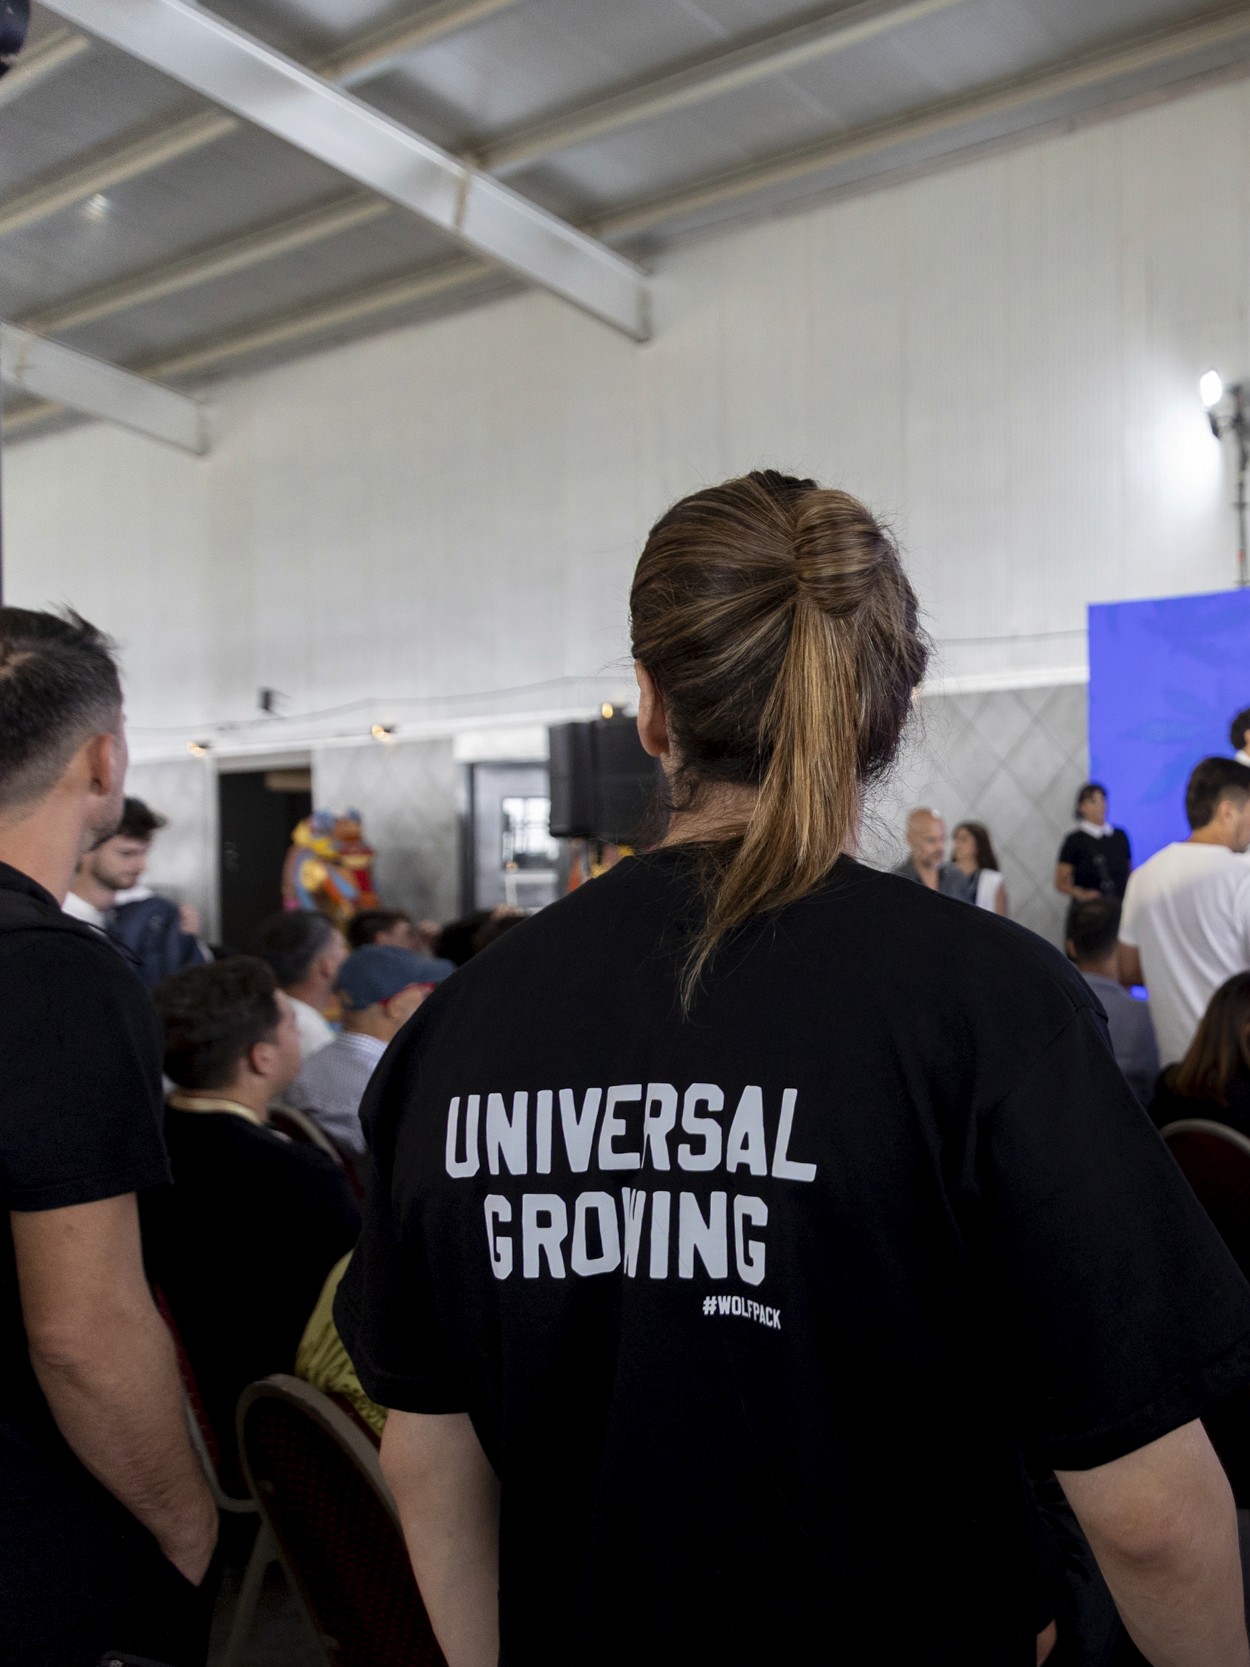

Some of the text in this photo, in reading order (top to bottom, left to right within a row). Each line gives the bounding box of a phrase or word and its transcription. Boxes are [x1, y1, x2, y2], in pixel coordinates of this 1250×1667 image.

[445, 1082, 818, 1182] UNIVERSAL
[483, 1186, 769, 1287] GROWING
[702, 1295, 782, 1330] #WOLFPACK
